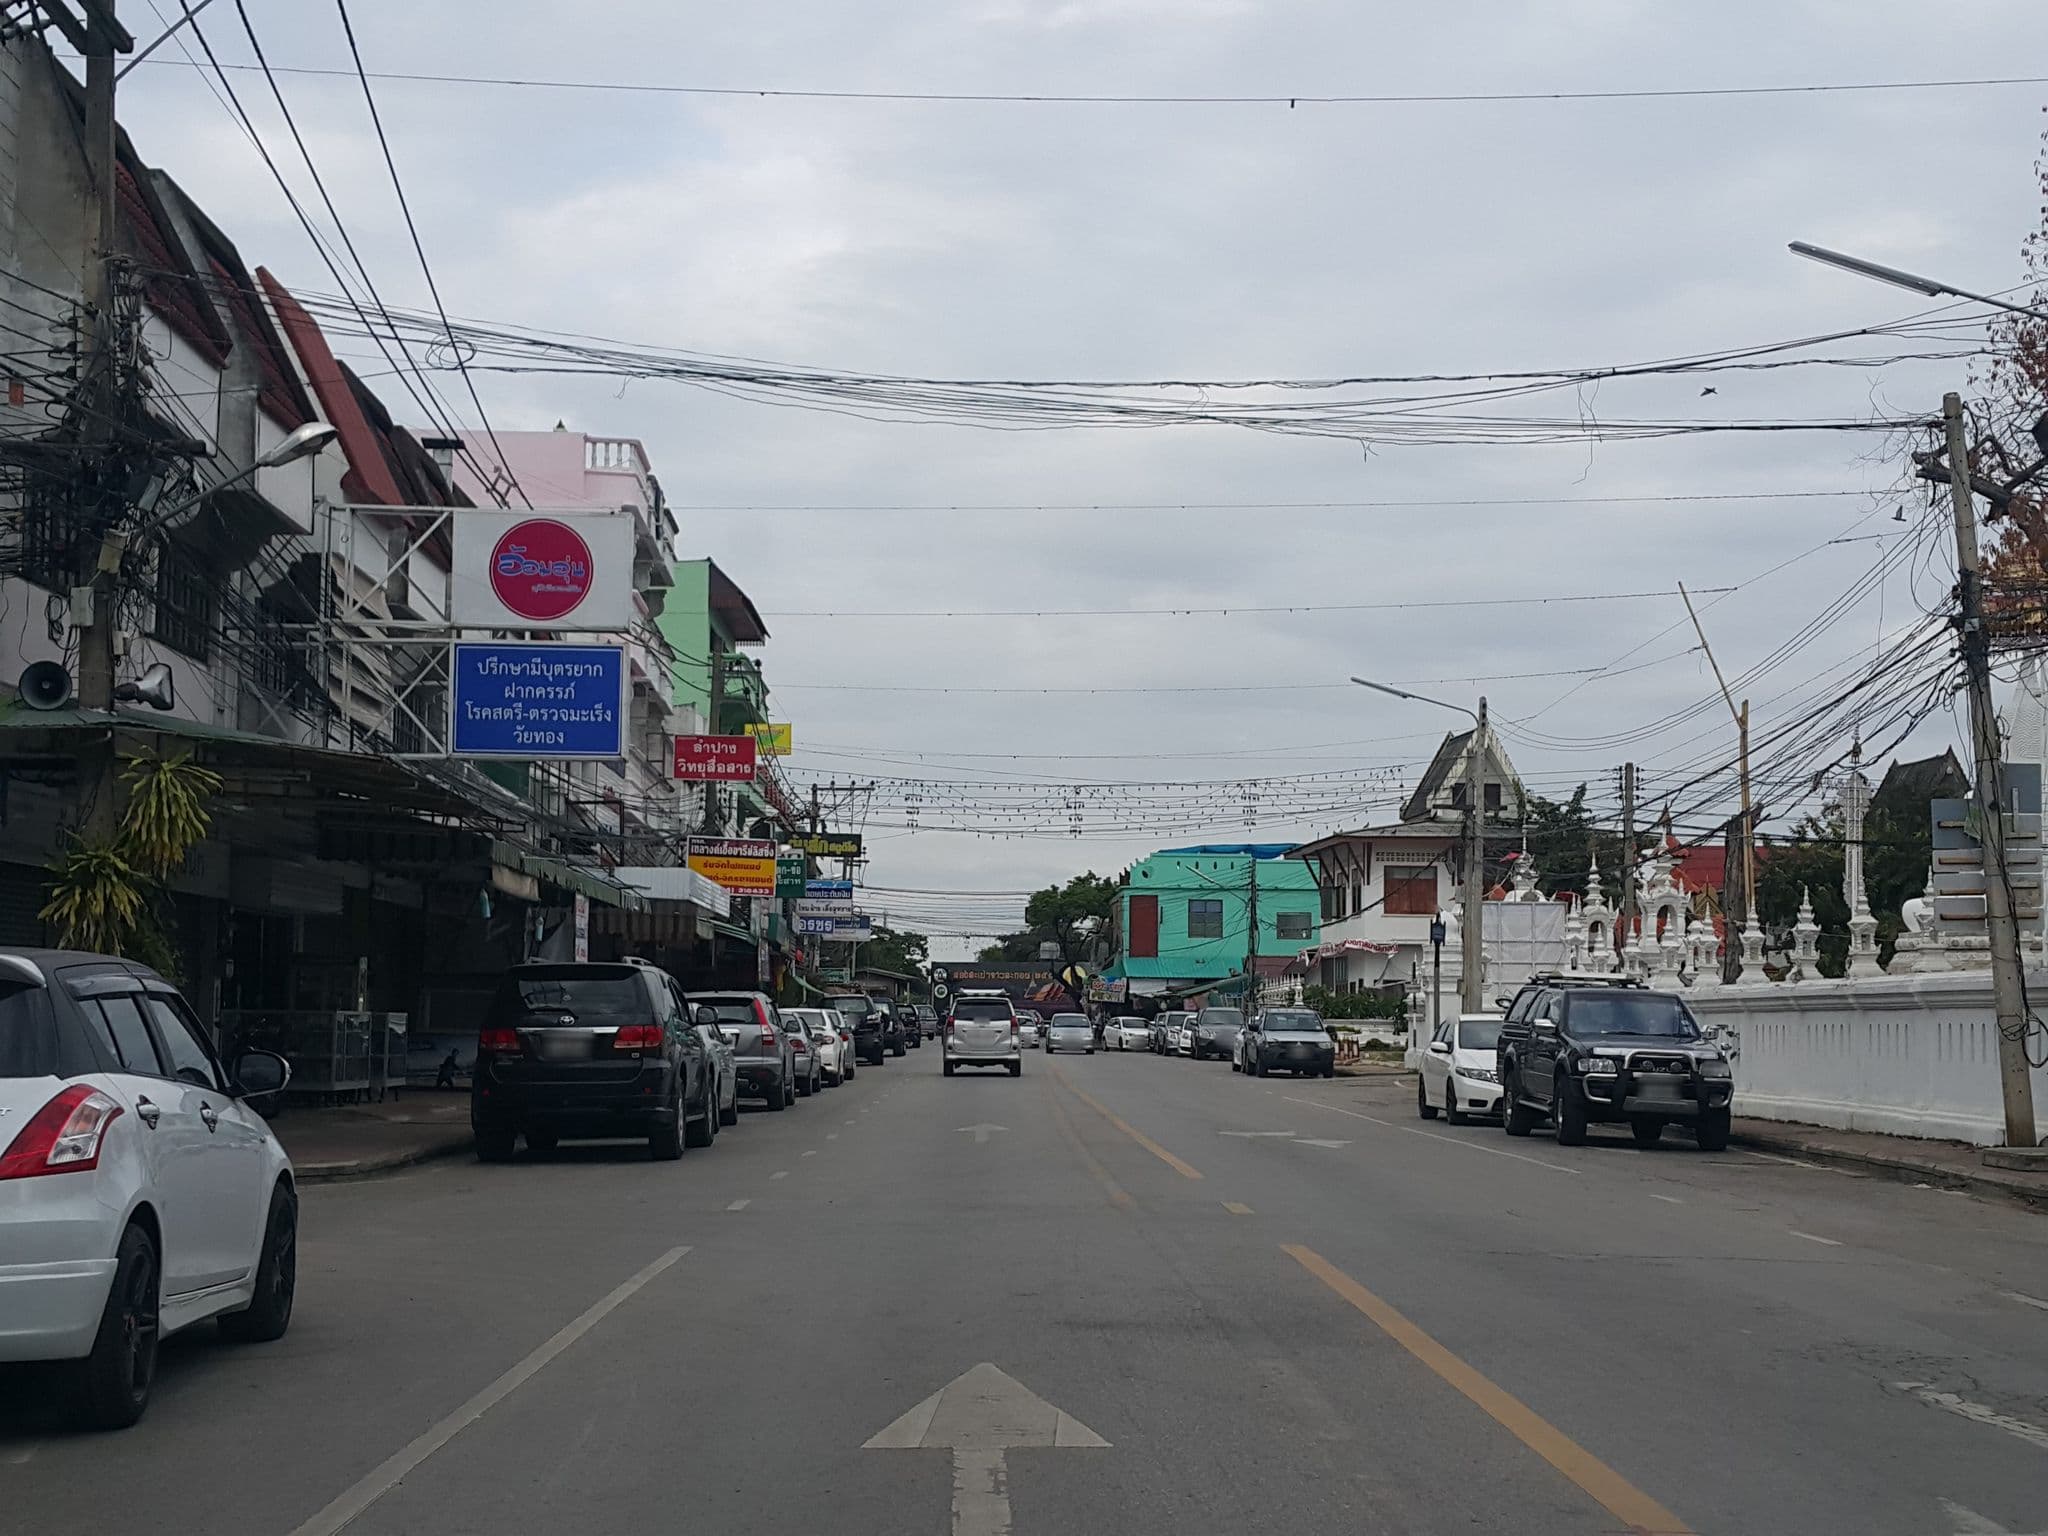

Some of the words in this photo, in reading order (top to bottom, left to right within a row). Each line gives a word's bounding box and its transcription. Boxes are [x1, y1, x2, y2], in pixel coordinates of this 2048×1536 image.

[477, 656, 603, 682] ปรึกษามีบุตรยาก
[504, 681, 575, 699] ฝากครรภ์
[465, 701, 612, 722] โรคสตรี-ตรวจมะเร็ง
[513, 725, 564, 744] วัยทอง
[693, 738, 737, 754] ลำปาง
[677, 755, 751, 777] วิทยุสื่อสาร
